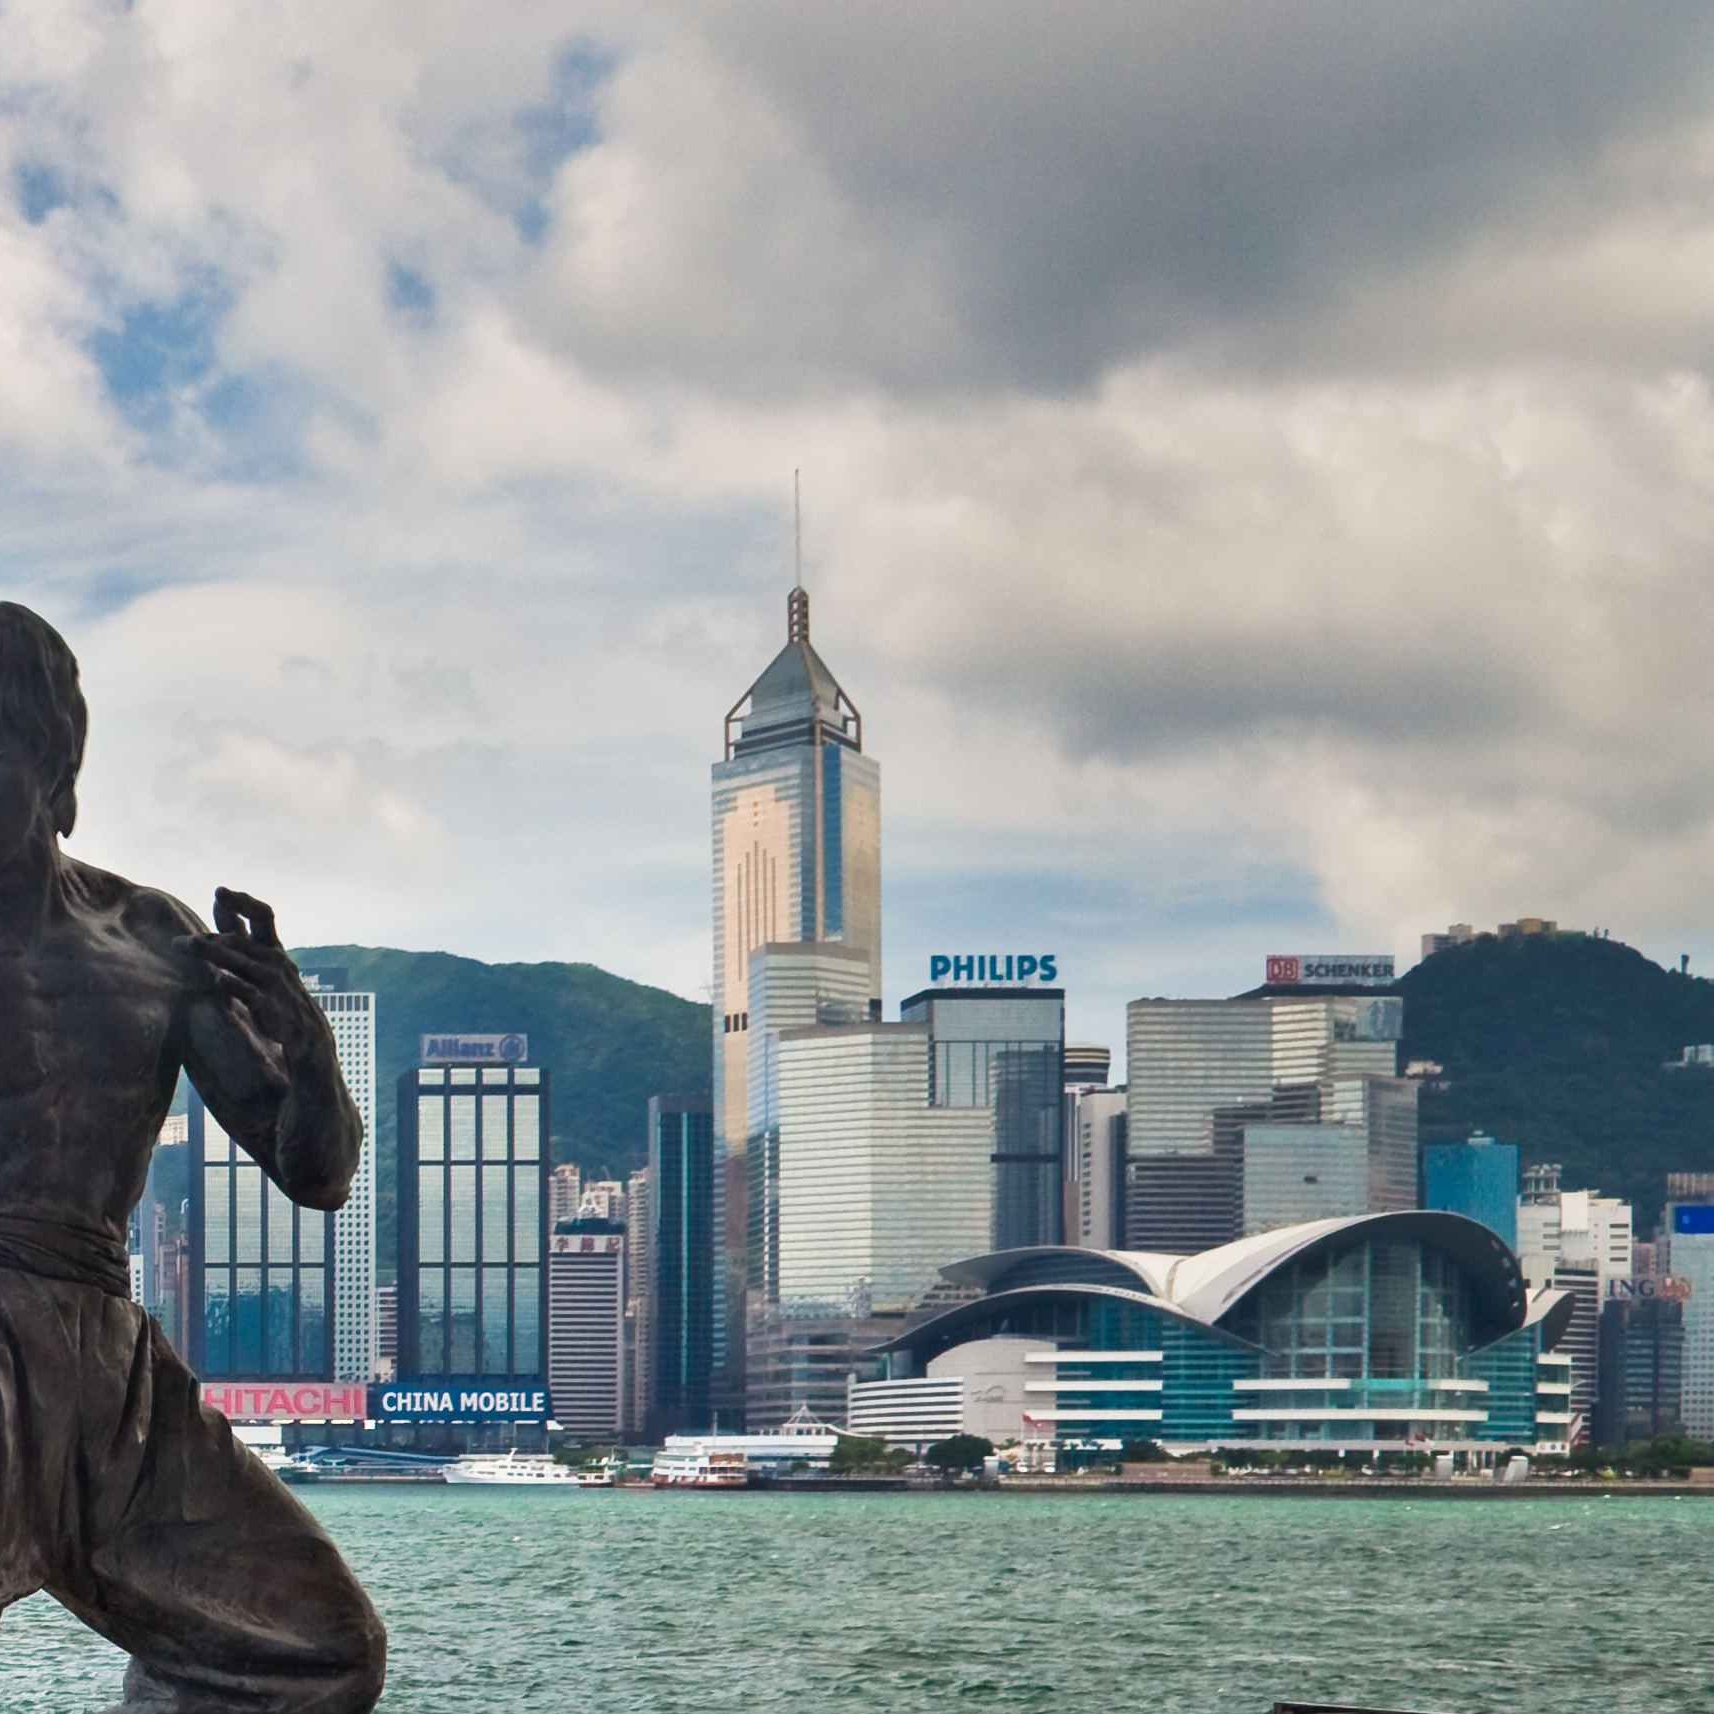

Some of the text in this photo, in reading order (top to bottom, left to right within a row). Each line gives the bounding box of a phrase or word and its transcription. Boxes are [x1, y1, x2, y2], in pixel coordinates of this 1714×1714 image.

[930, 954, 1057, 981] PHILIPS
[1271, 960, 1395, 979] DB SCHENKER
[426, 1038, 495, 1058] Allianz
[1609, 1279, 1655, 1296] ING
[204, 1388, 364, 1415] HITACHI
[382, 1391, 546, 1412] CHINA MOBILE
